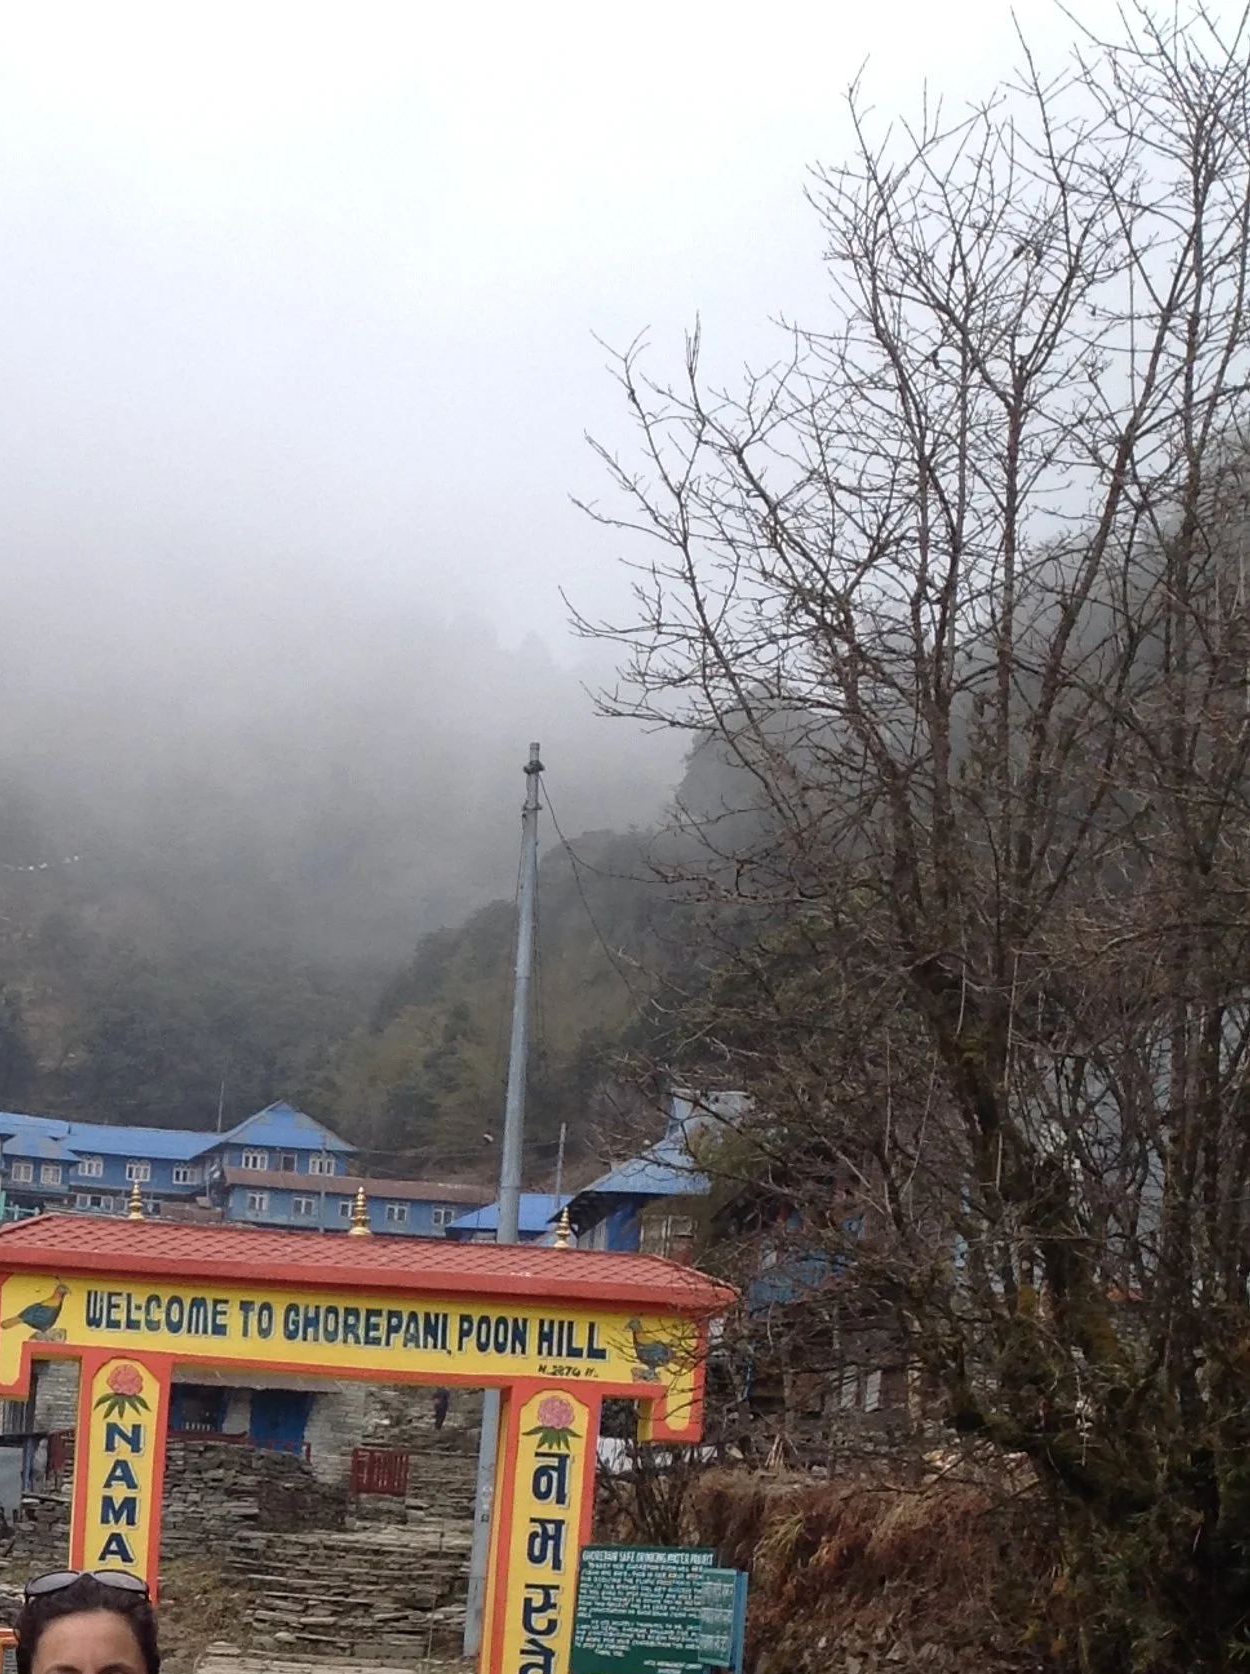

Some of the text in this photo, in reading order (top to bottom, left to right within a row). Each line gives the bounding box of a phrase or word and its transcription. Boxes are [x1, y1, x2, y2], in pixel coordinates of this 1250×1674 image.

[239, 1300, 274, 1339] TO
[457, 1314, 529, 1356] POON
[537, 1318, 608, 1360] HILL
[98, 1422, 144, 1565] NAMA
